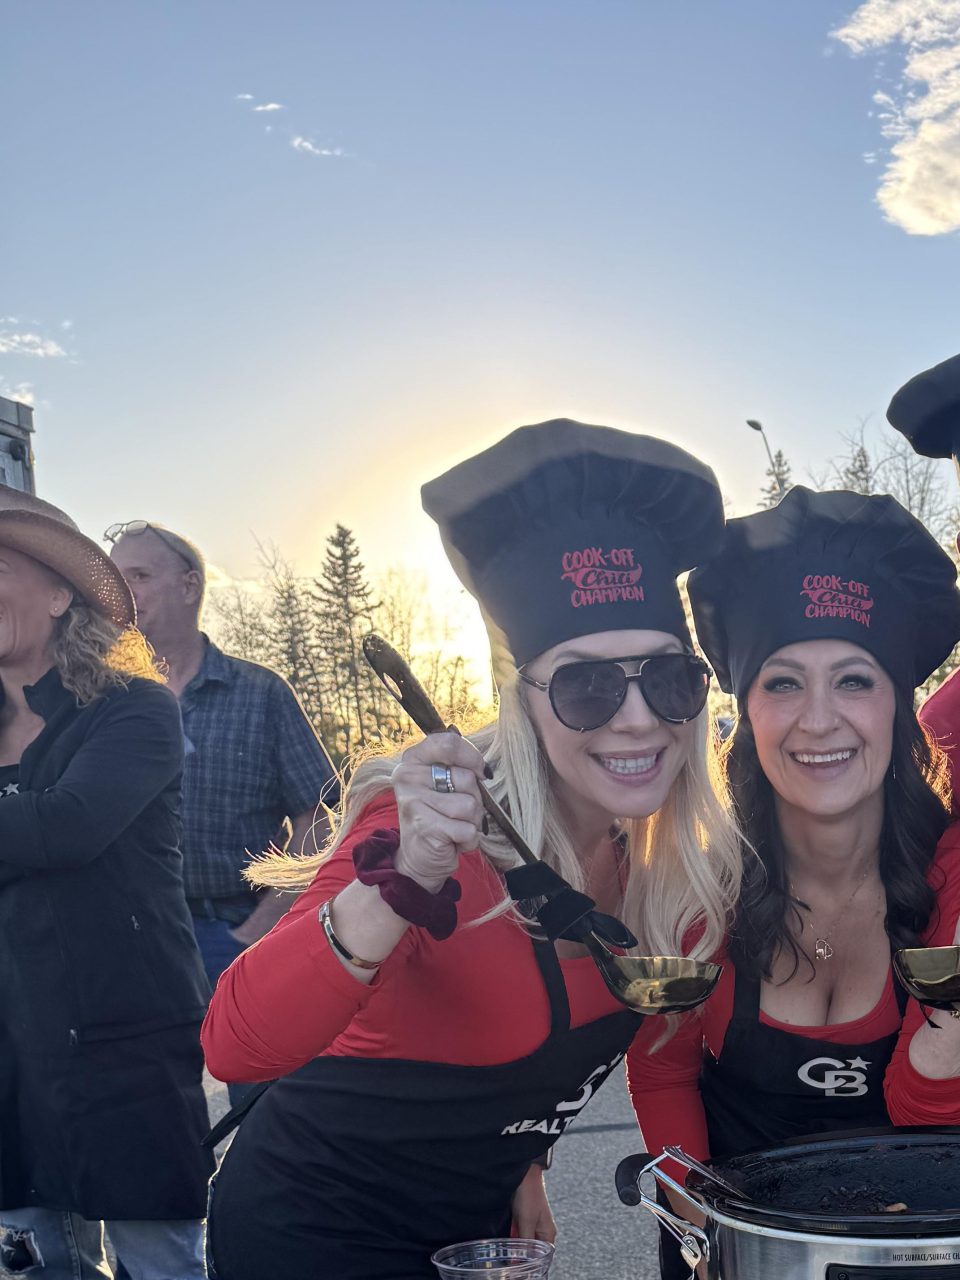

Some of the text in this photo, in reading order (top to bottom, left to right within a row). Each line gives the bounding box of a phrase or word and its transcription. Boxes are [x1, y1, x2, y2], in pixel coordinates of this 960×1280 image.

[562, 547, 634, 572] COOK-OFF
[571, 586, 645, 608] CHAMPION
[802, 575, 869, 597] COOK-OFF
[804, 604, 871, 628] CHAMPION
